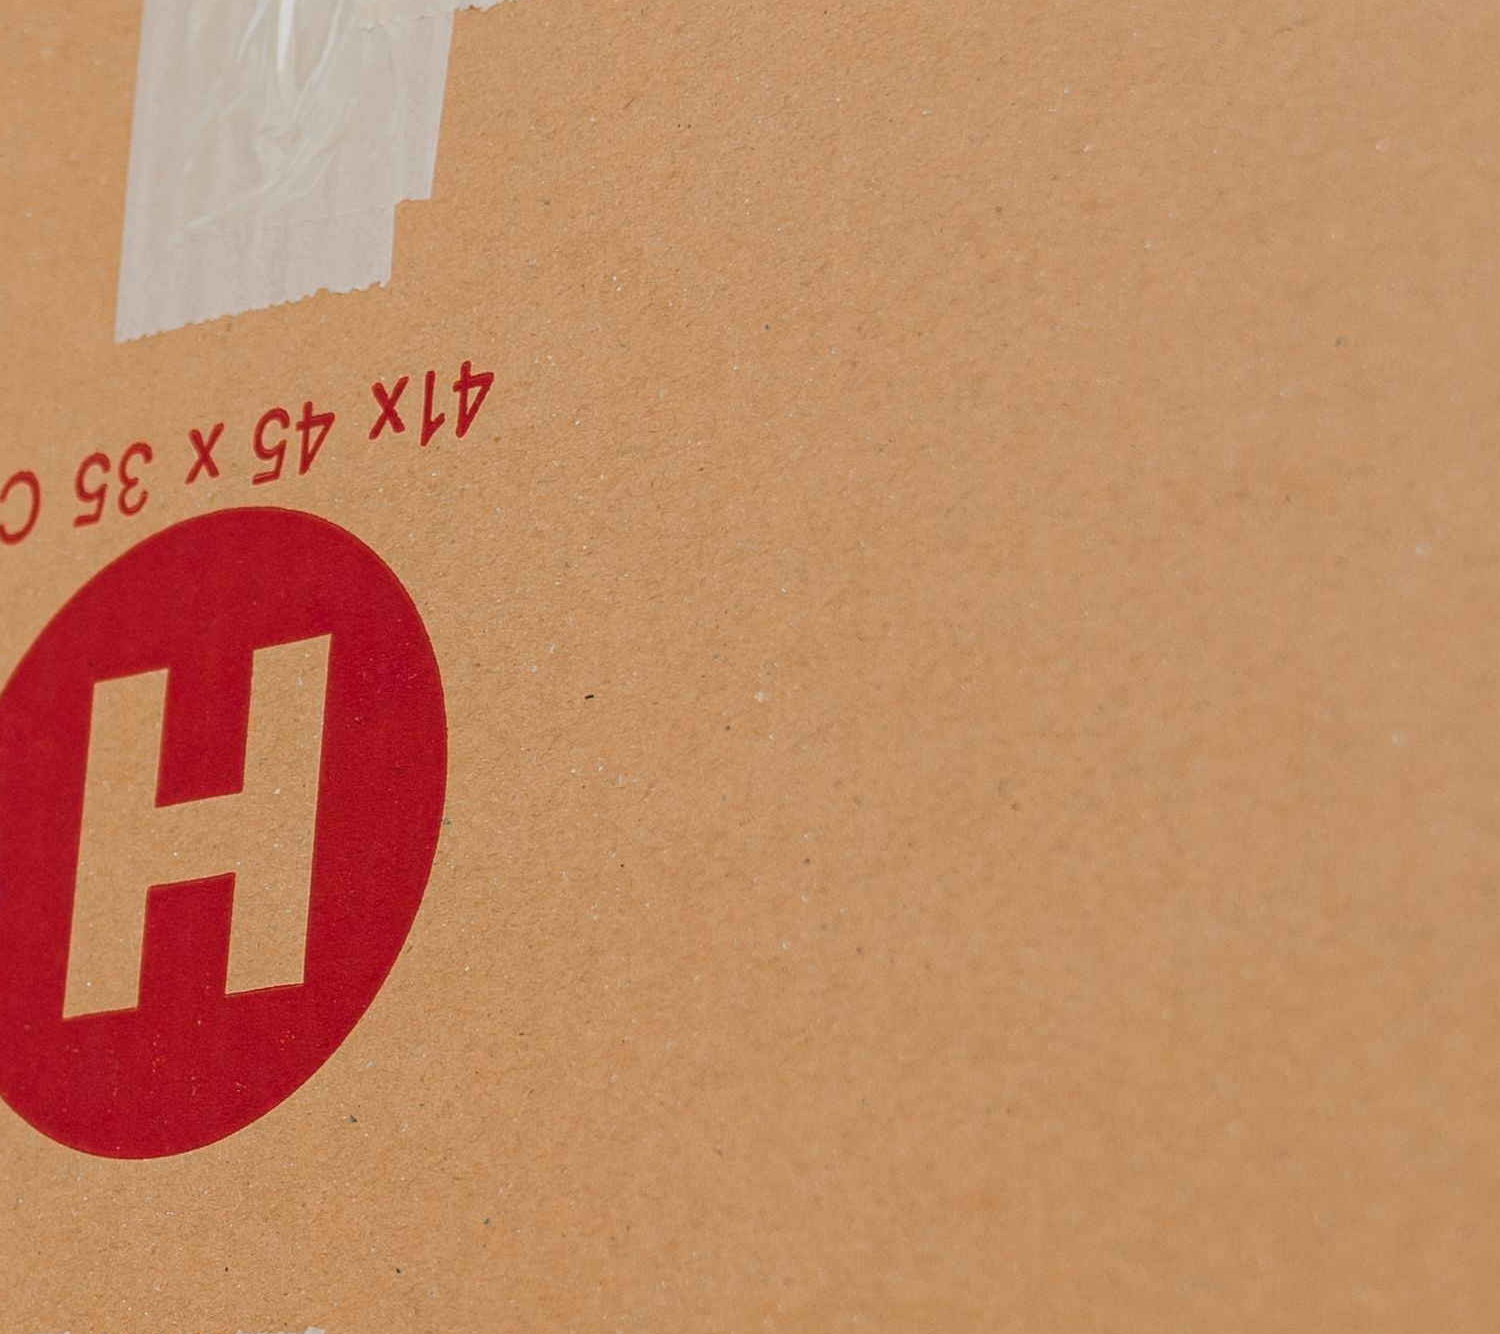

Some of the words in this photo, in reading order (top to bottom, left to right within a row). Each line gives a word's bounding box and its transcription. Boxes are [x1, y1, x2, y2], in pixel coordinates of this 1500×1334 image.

[73, 442, 153, 527] 35
[186, 423, 224, 484] x
[252, 401, 335, 485] 45
[63, 635, 331, 1018] H
